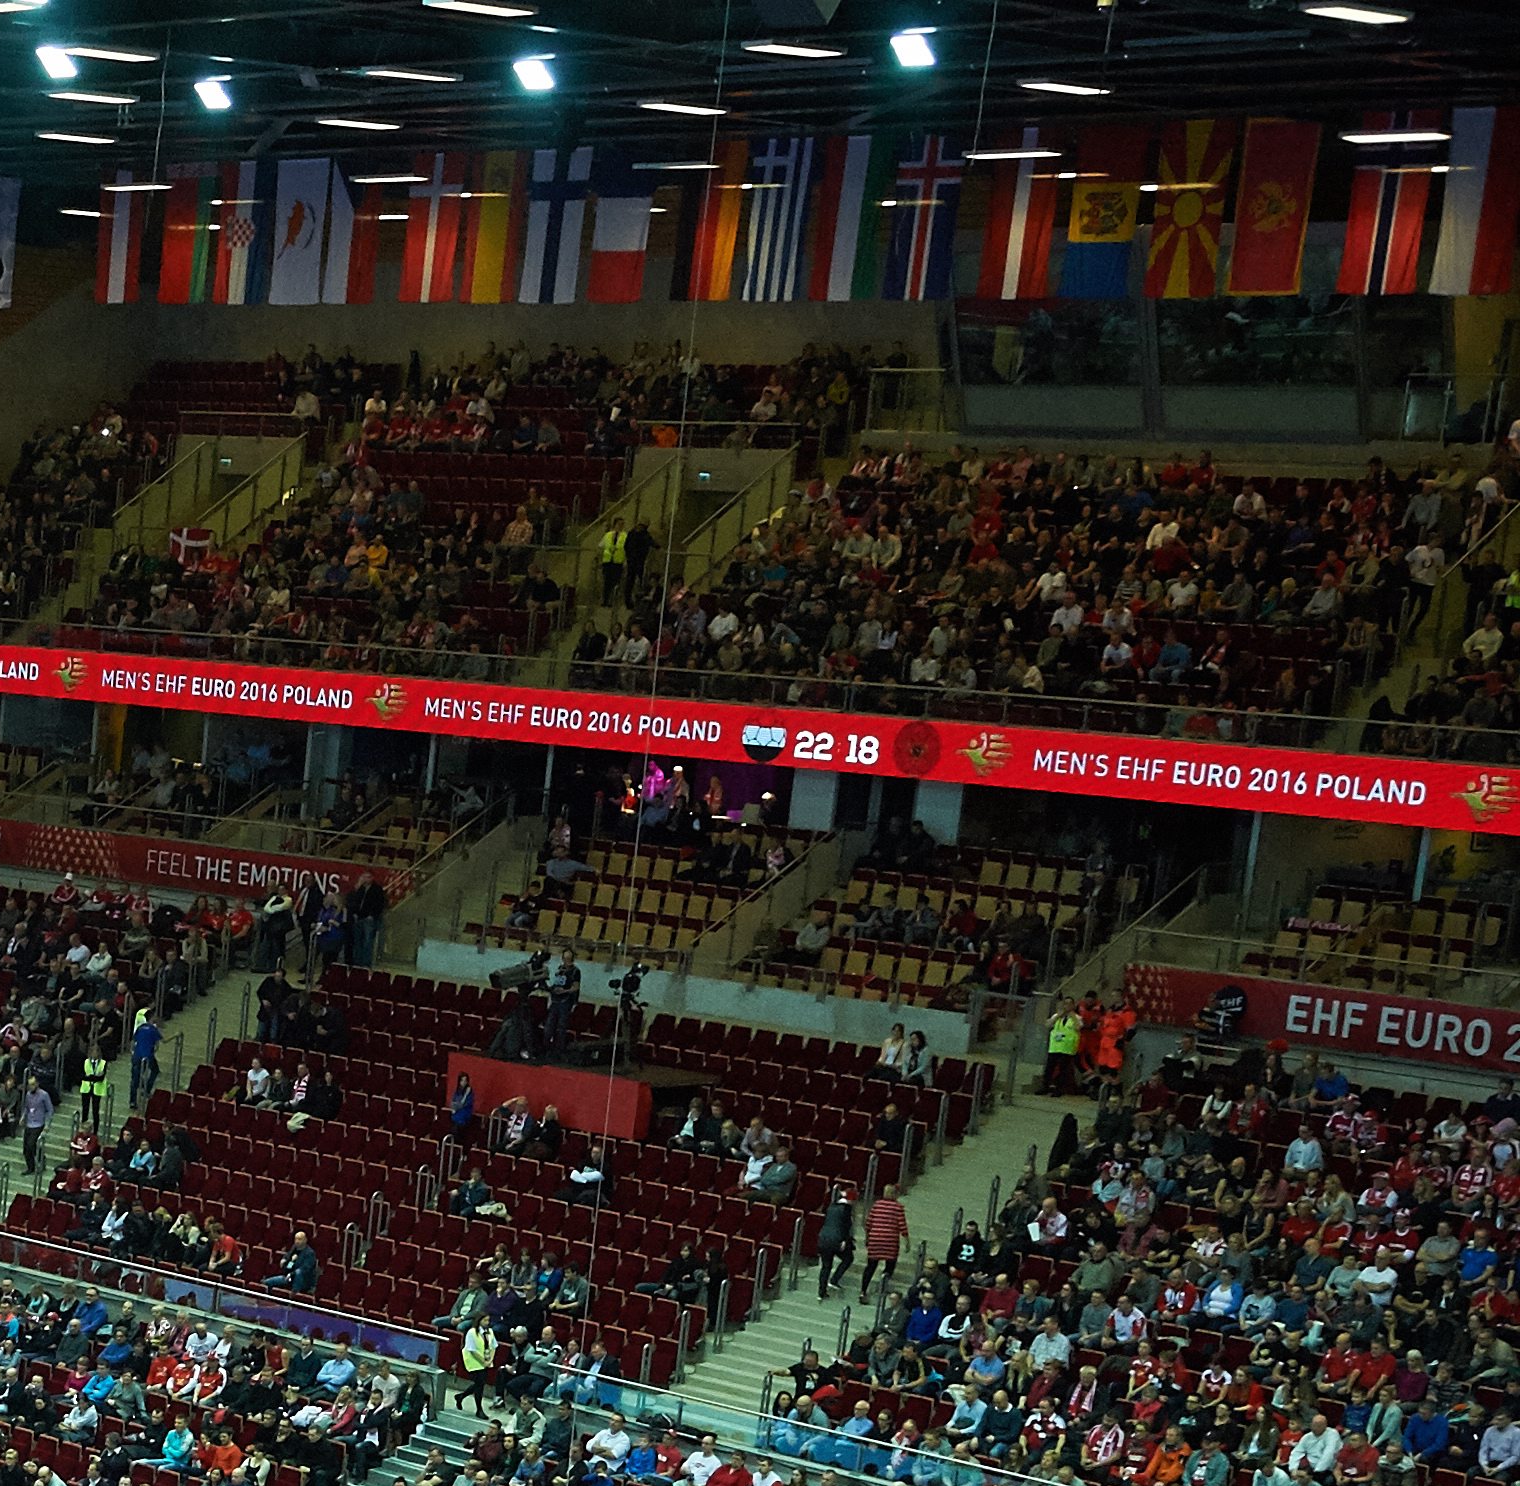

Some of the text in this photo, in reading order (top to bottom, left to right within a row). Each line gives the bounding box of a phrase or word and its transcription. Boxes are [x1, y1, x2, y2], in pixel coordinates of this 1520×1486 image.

[101, 669, 353, 710] MEN'S EHF EURO 2016 POLAND
[424, 697, 721, 743] MEN'S EHF EURO 2016 POLAND
[793, 731, 879, 765] 22 18
[1033, 749, 1426, 806] MEN'S EHF EURO 2016 POLAND
[145, 848, 192, 876] FEEL
[195, 856, 232, 884] THE
[1285, 994, 1367, 1039] EHF
[1376, 1006, 1492, 1057] EURO
